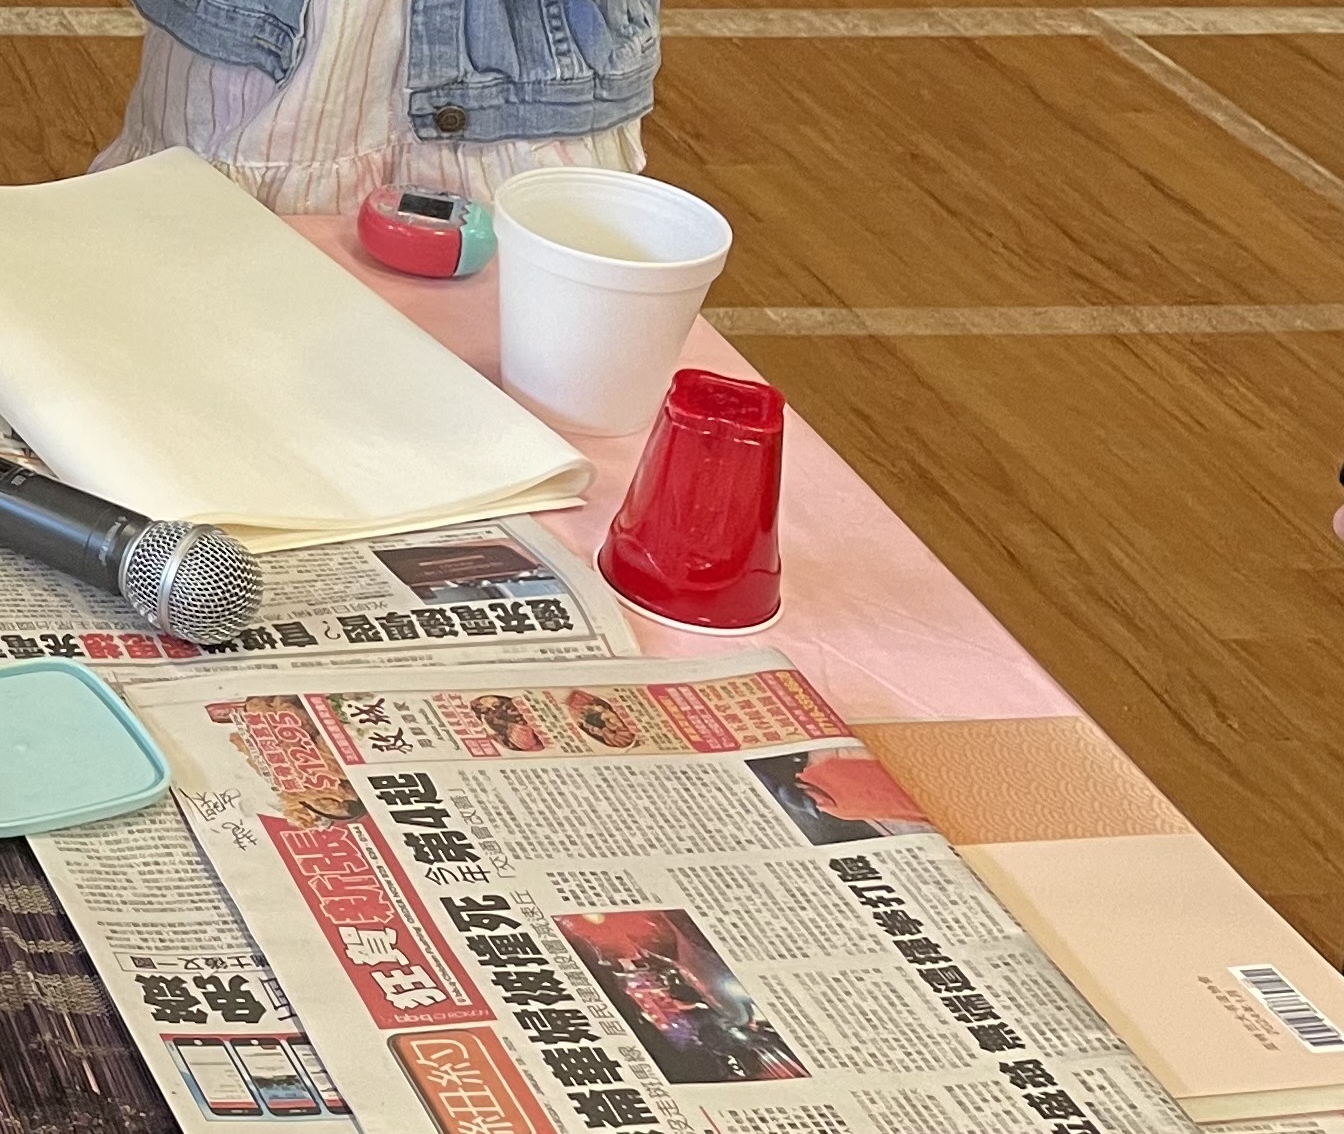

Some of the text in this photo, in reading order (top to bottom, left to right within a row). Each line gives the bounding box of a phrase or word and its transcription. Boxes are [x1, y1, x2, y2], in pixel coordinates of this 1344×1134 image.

[265, 711, 342, 793] $12.95
[130, 953, 270, 970] 士後又一國
[279, 826, 449, 1010] 狂賀新張
[440, 895, 660, 1134] 崙華婦被撞死
